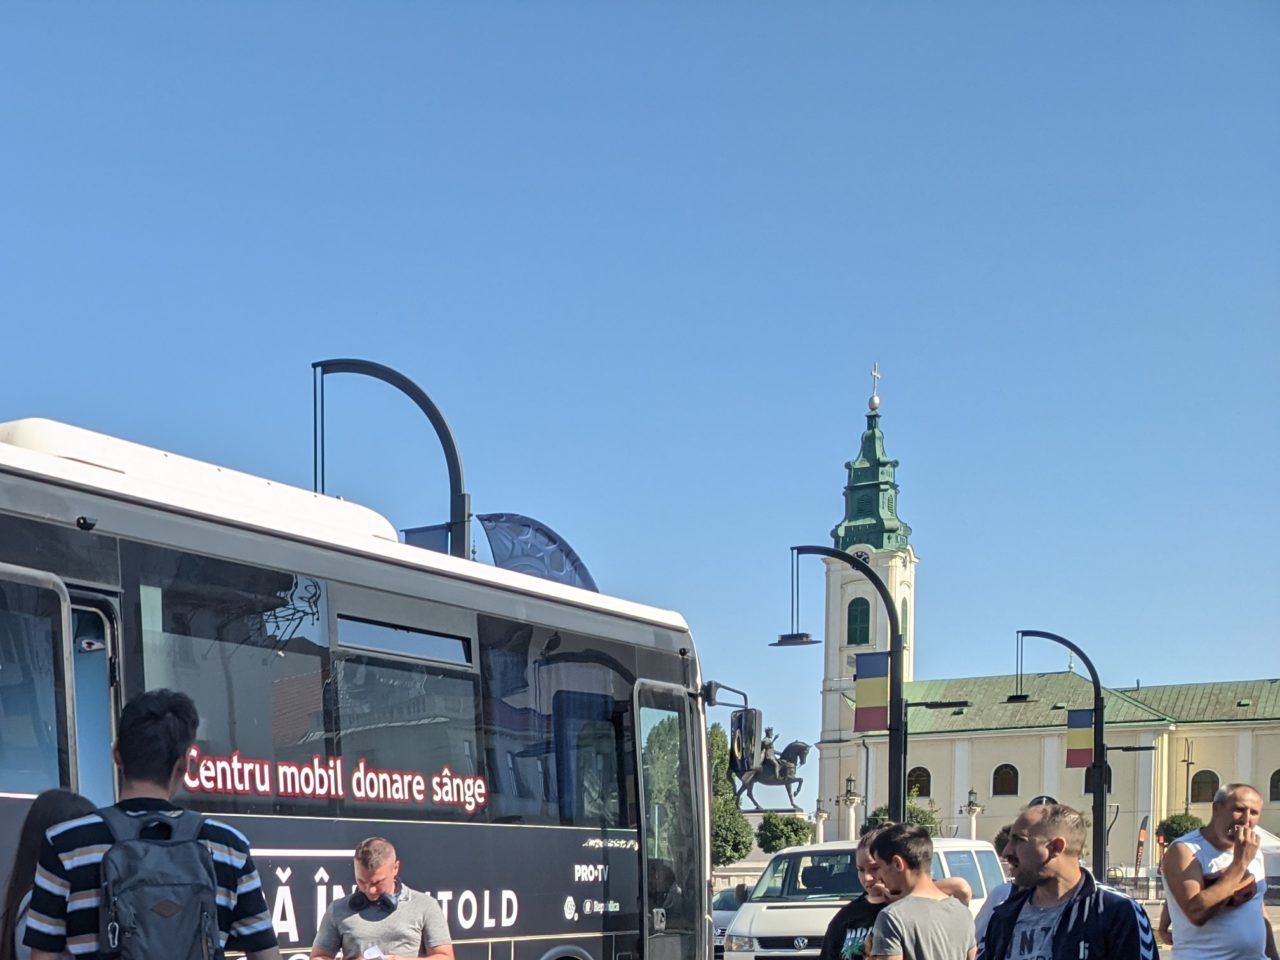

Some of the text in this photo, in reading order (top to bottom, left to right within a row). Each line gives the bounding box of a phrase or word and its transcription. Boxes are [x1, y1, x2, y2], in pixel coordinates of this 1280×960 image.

[184, 748, 486, 811] Centru mobil donare sânge
